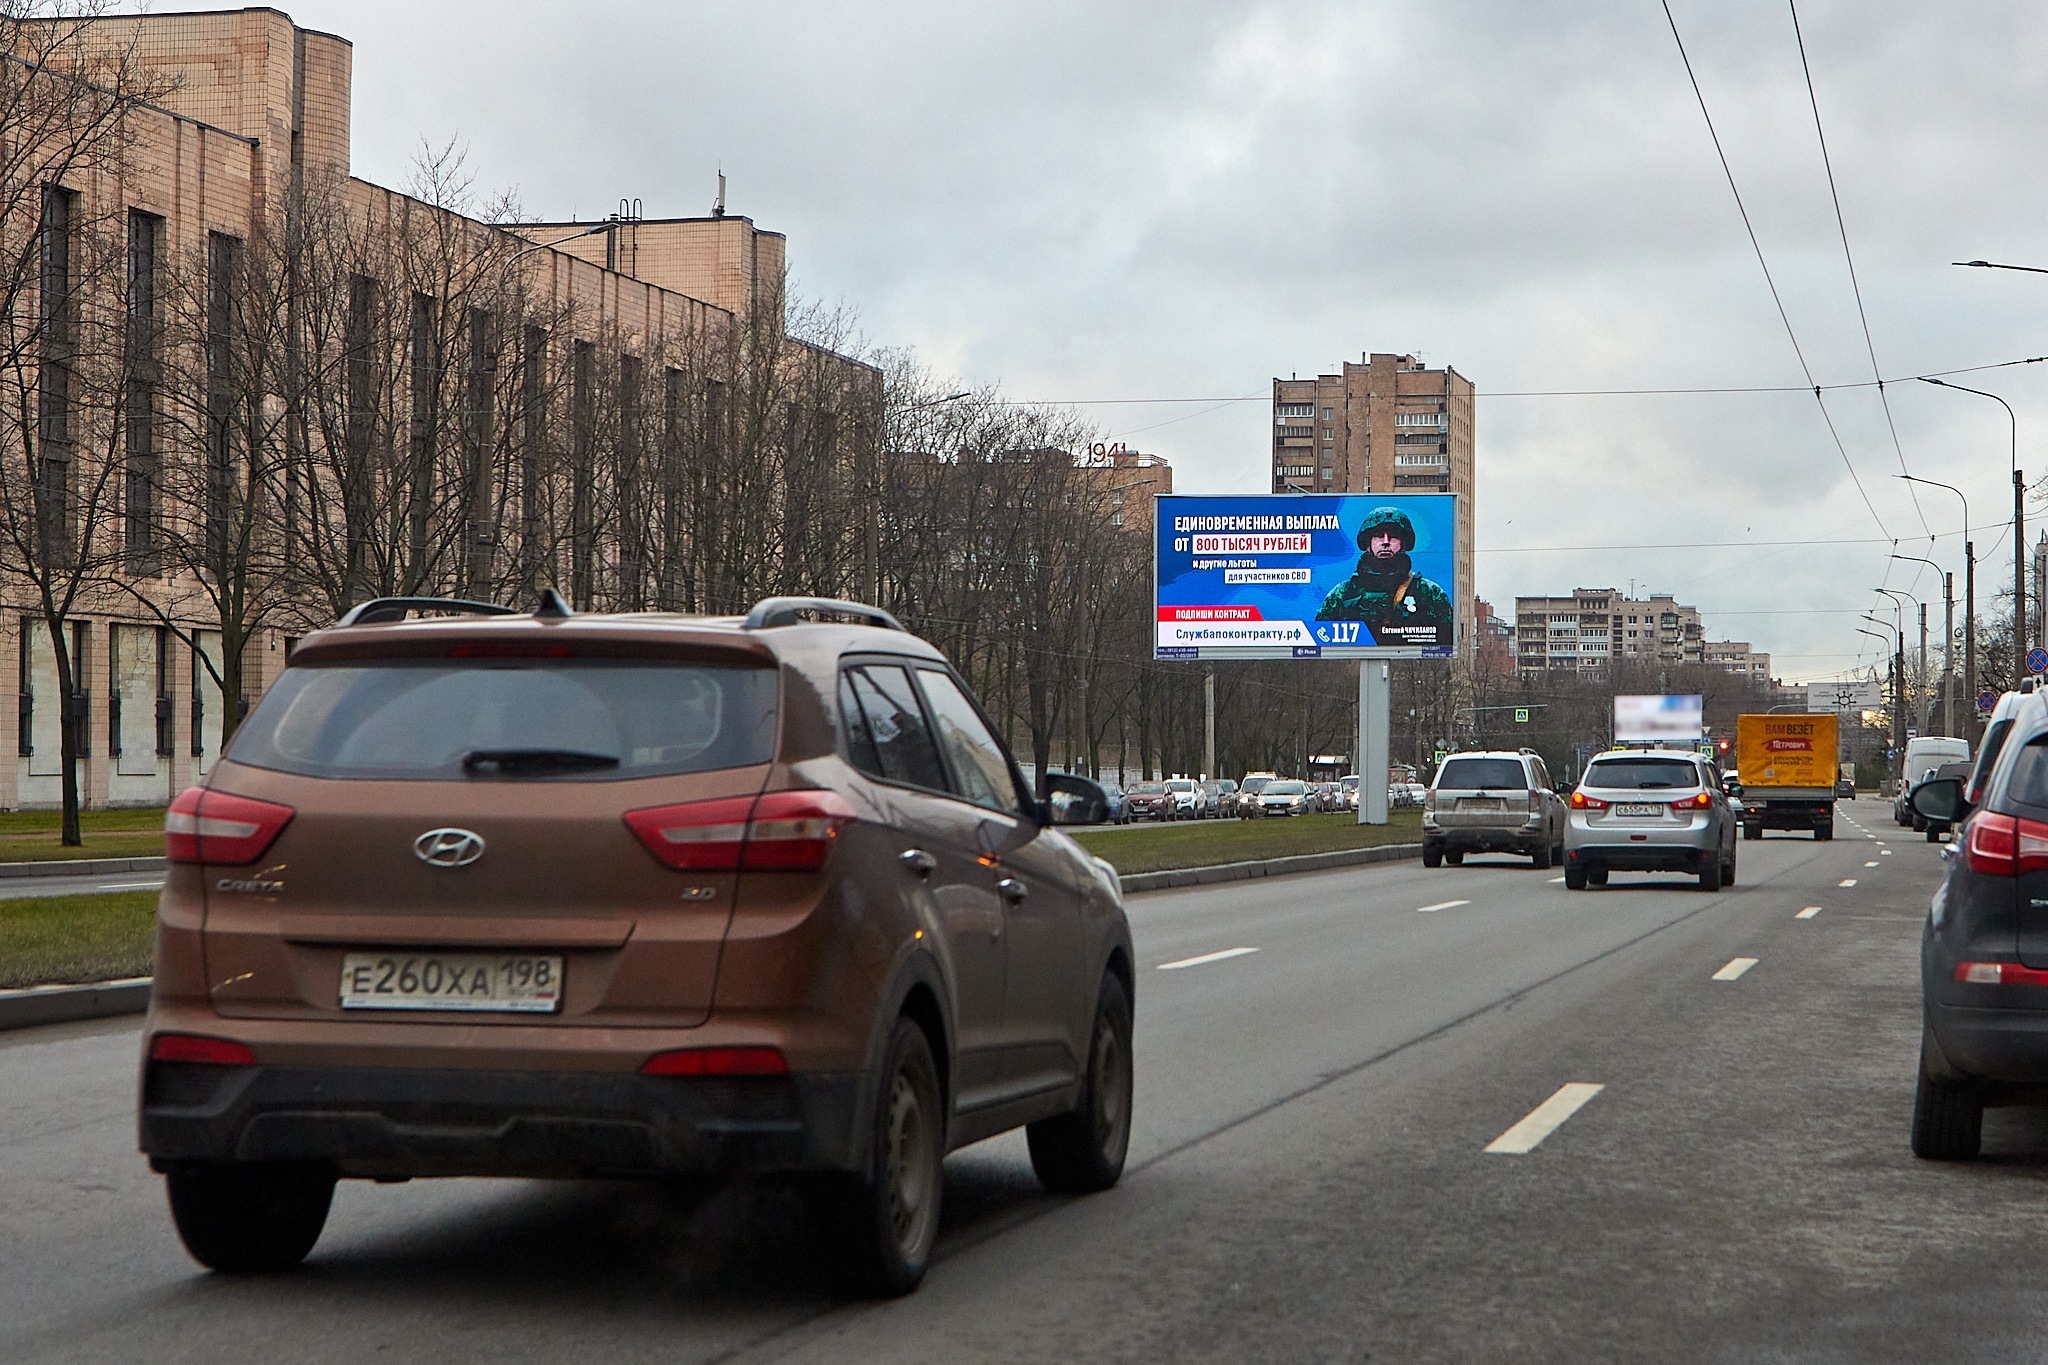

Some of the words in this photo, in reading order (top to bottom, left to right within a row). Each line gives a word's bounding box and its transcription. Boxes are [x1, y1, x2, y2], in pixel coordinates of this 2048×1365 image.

[1087, 442, 1127, 462] 1941
[1174, 516, 1282, 532] ЕДИНОВРЕМЕННАЯ
[1286, 516, 1340, 530] ВЫПЛАТА
[1174, 538, 1189, 551] ОТ
[1196, 538, 1218, 550] 800
[1222, 538, 1260, 550] ТЫСЯЧ
[1264, 534, 1308, 550] РУБЛЕЙ
[1199, 560, 1227, 570] другие
[1228, 560, 1256, 568] льготы
[1228, 574, 1243, 582] для
[1244, 573, 1290, 582] участников
[1292, 572, 1306, 580] СВО
[1176, 610, 1212, 619] ПОДПИШИ
[1214, 610, 1250, 619] КОНТРАКТ
[1176, 628, 1301, 640] Службапоконтракту.рф
[1332, 623, 1359, 642] 117
[1766, 724, 1785, 734] ВАМ
[1786, 722, 1814, 734] ВЕЗЁТ
